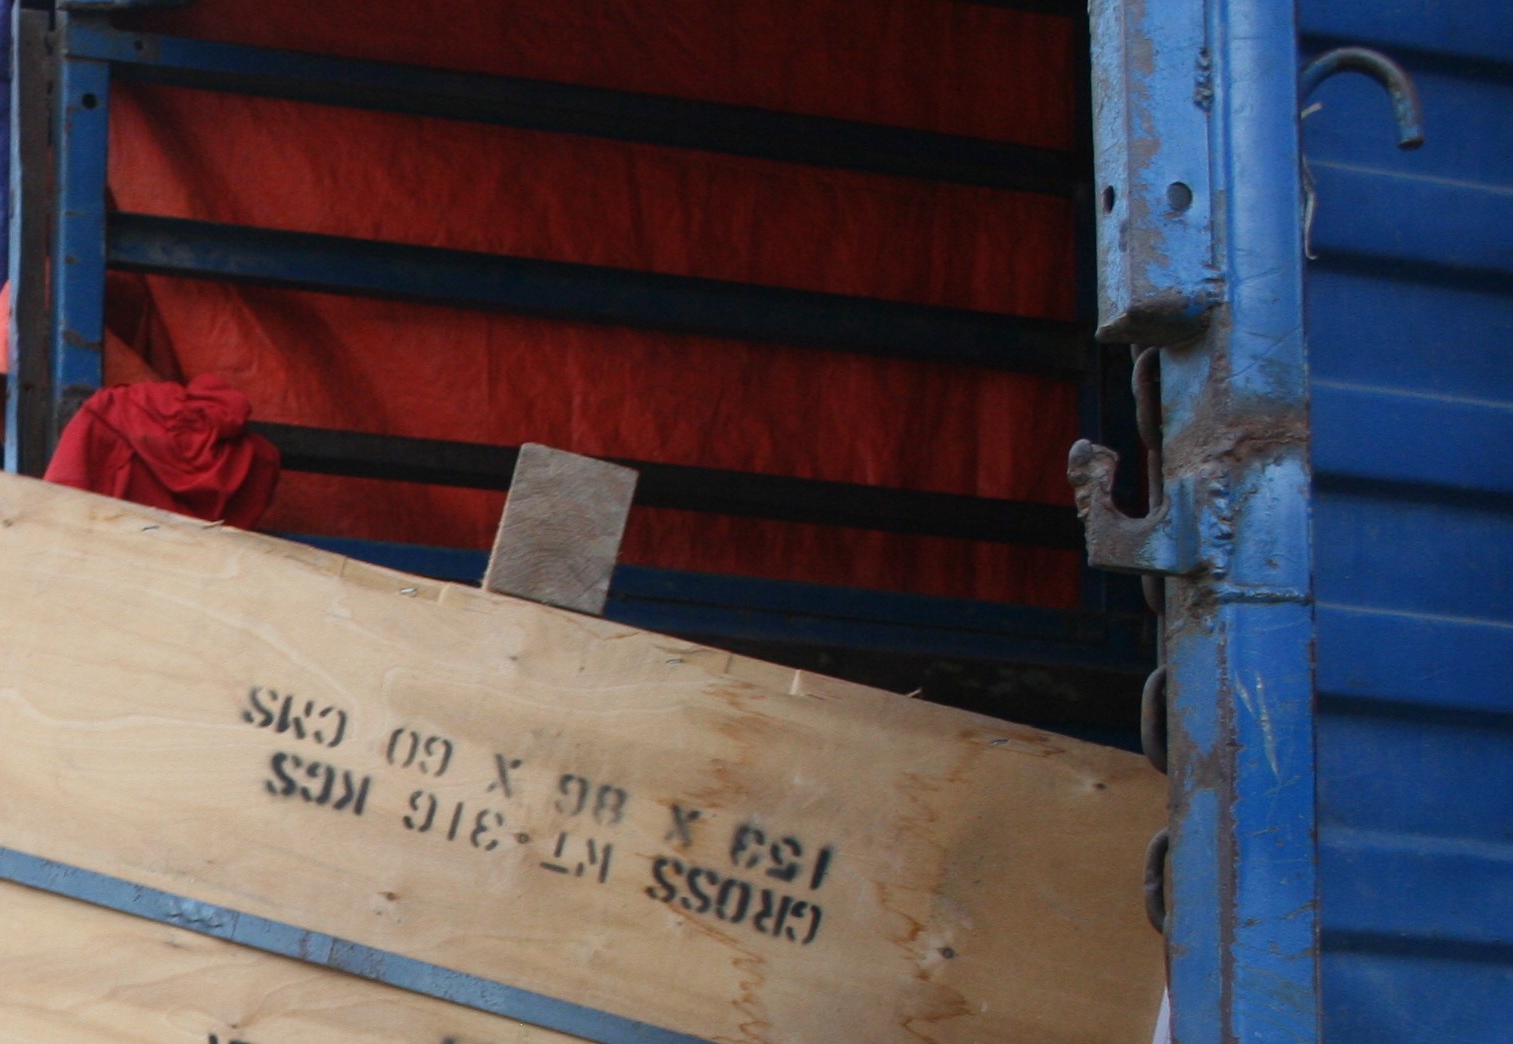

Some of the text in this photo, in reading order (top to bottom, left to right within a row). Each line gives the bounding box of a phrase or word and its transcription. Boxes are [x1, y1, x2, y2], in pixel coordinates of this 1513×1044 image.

[241, 686, 835, 892] 153 X 86 X 60 CMS
[263, 751, 372, 816] KGS
[402, 789, 504, 851] 316
[643, 856, 824, 946] GROSS
